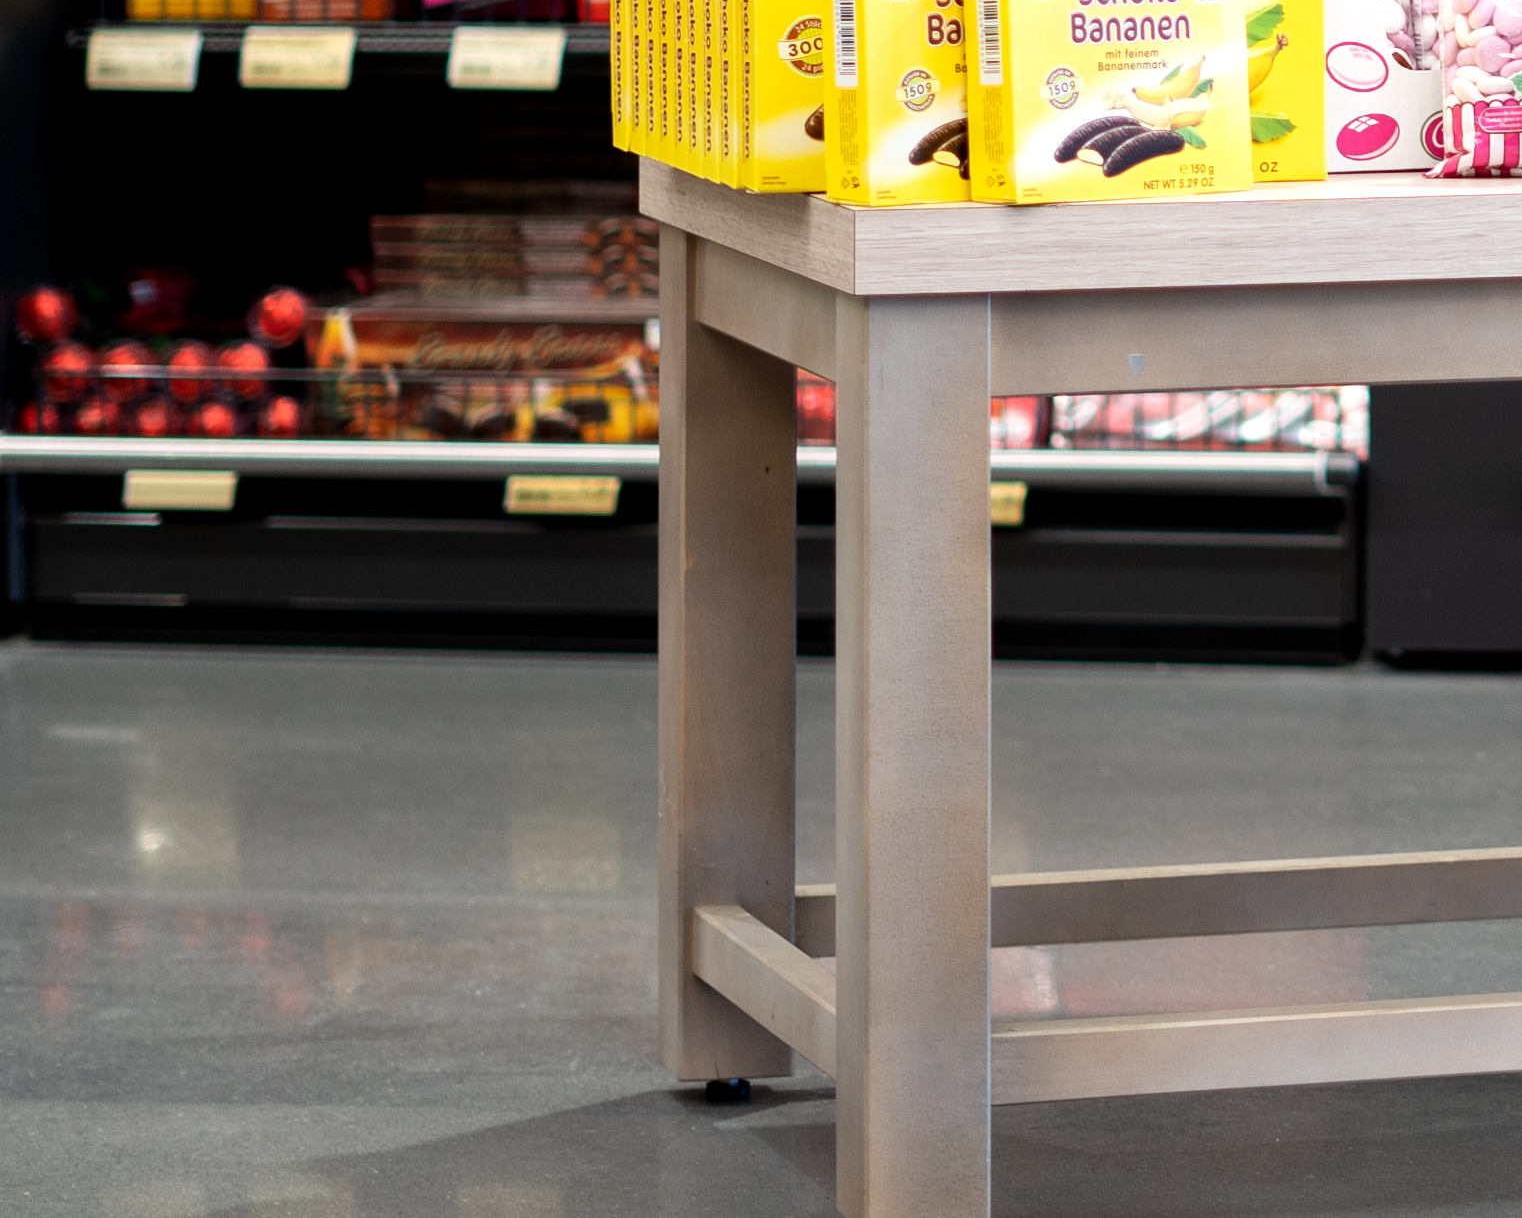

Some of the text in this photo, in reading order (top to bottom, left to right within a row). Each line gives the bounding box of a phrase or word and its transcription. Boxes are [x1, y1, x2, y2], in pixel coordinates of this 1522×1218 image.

[1071, 12, 1191, 44] Bananen
[1105, 48, 1160, 59] mit feinem
[1098, 60, 1168, 72] Bananenmark
[1190, 163, 1206, 174] 150
[1260, 162, 1278, 173] OZ
[1143, 177, 1215, 190] NET WT 5.29 OZ
